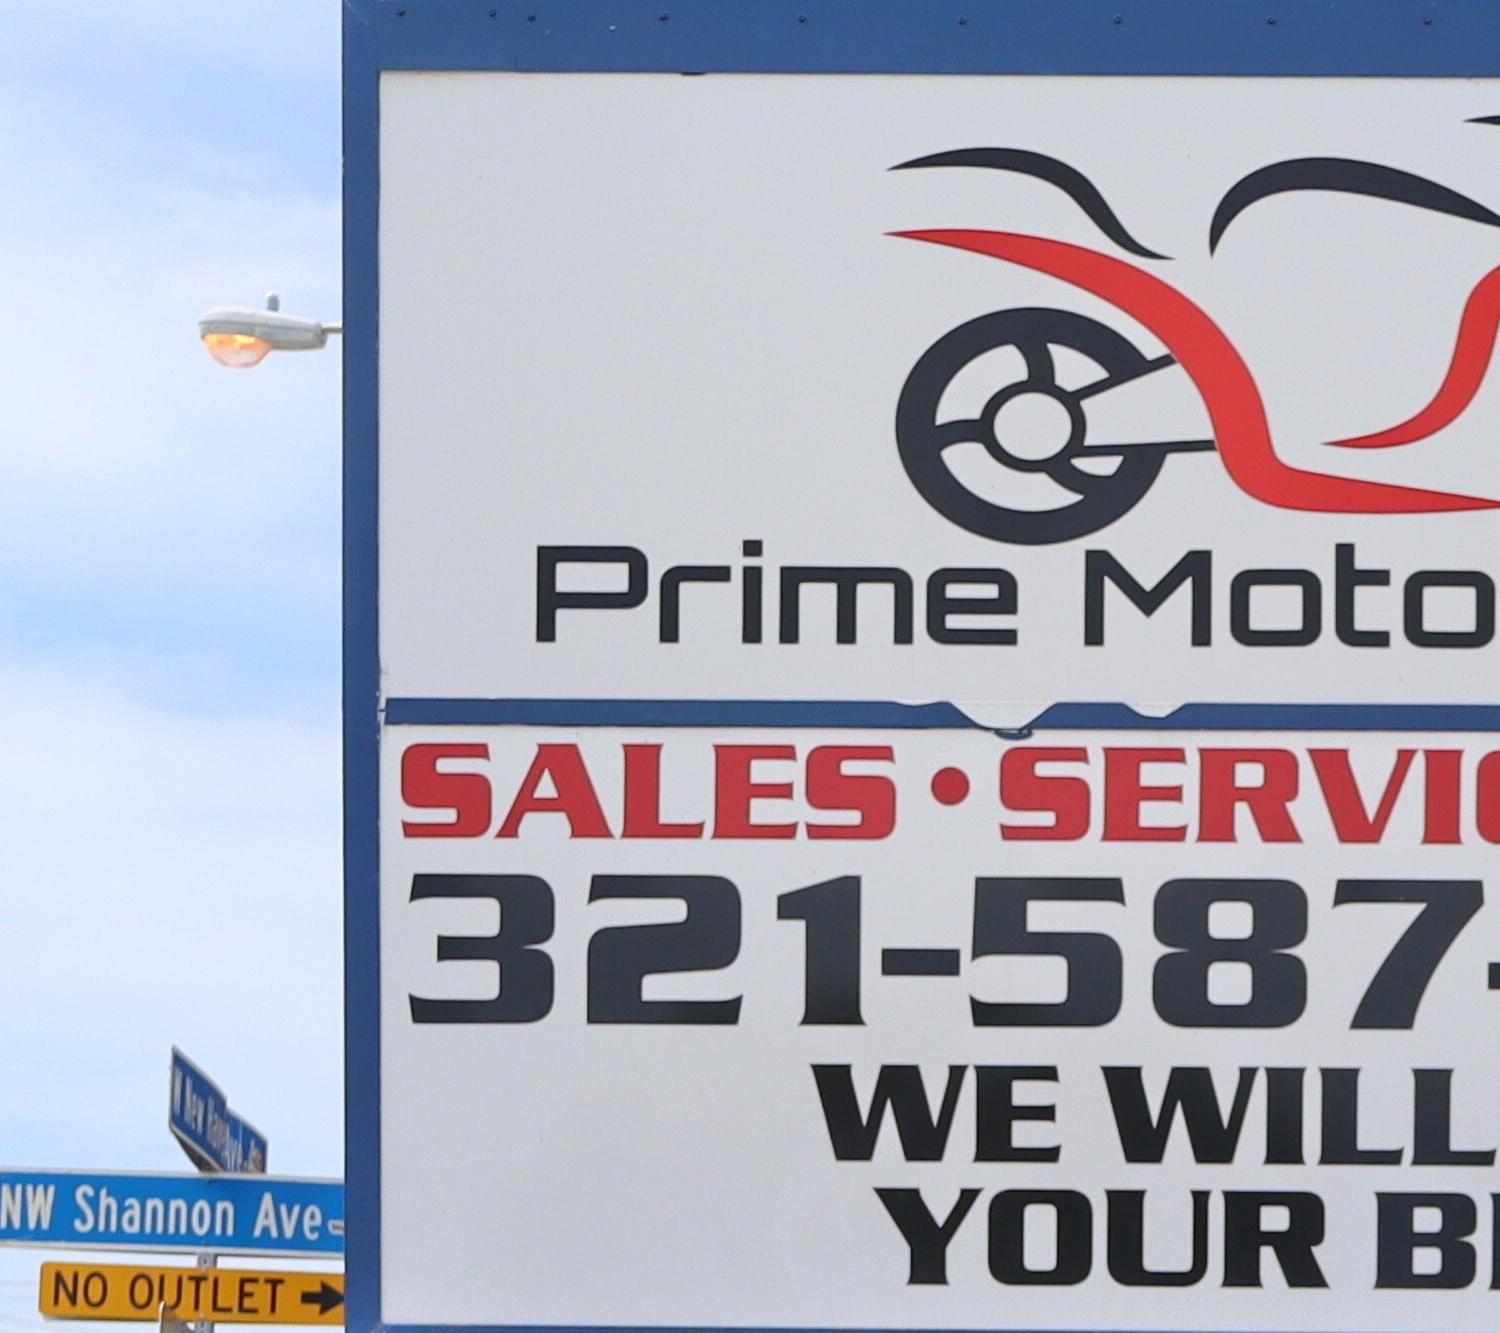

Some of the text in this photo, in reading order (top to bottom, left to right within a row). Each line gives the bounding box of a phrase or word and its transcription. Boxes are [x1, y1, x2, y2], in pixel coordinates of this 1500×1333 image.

[535, 540, 1018, 646] Prime
[402, 743, 896, 840] SALES
[810, 1063, 1062, 1164] WE
[1100, 1065, 1497, 1167] WILL
[0, 1184, 322, 1241] NW Shannon Ave
[873, 1187, 1330, 1289] YOUR
[53, 1271, 285, 1315] NO OUTLET
